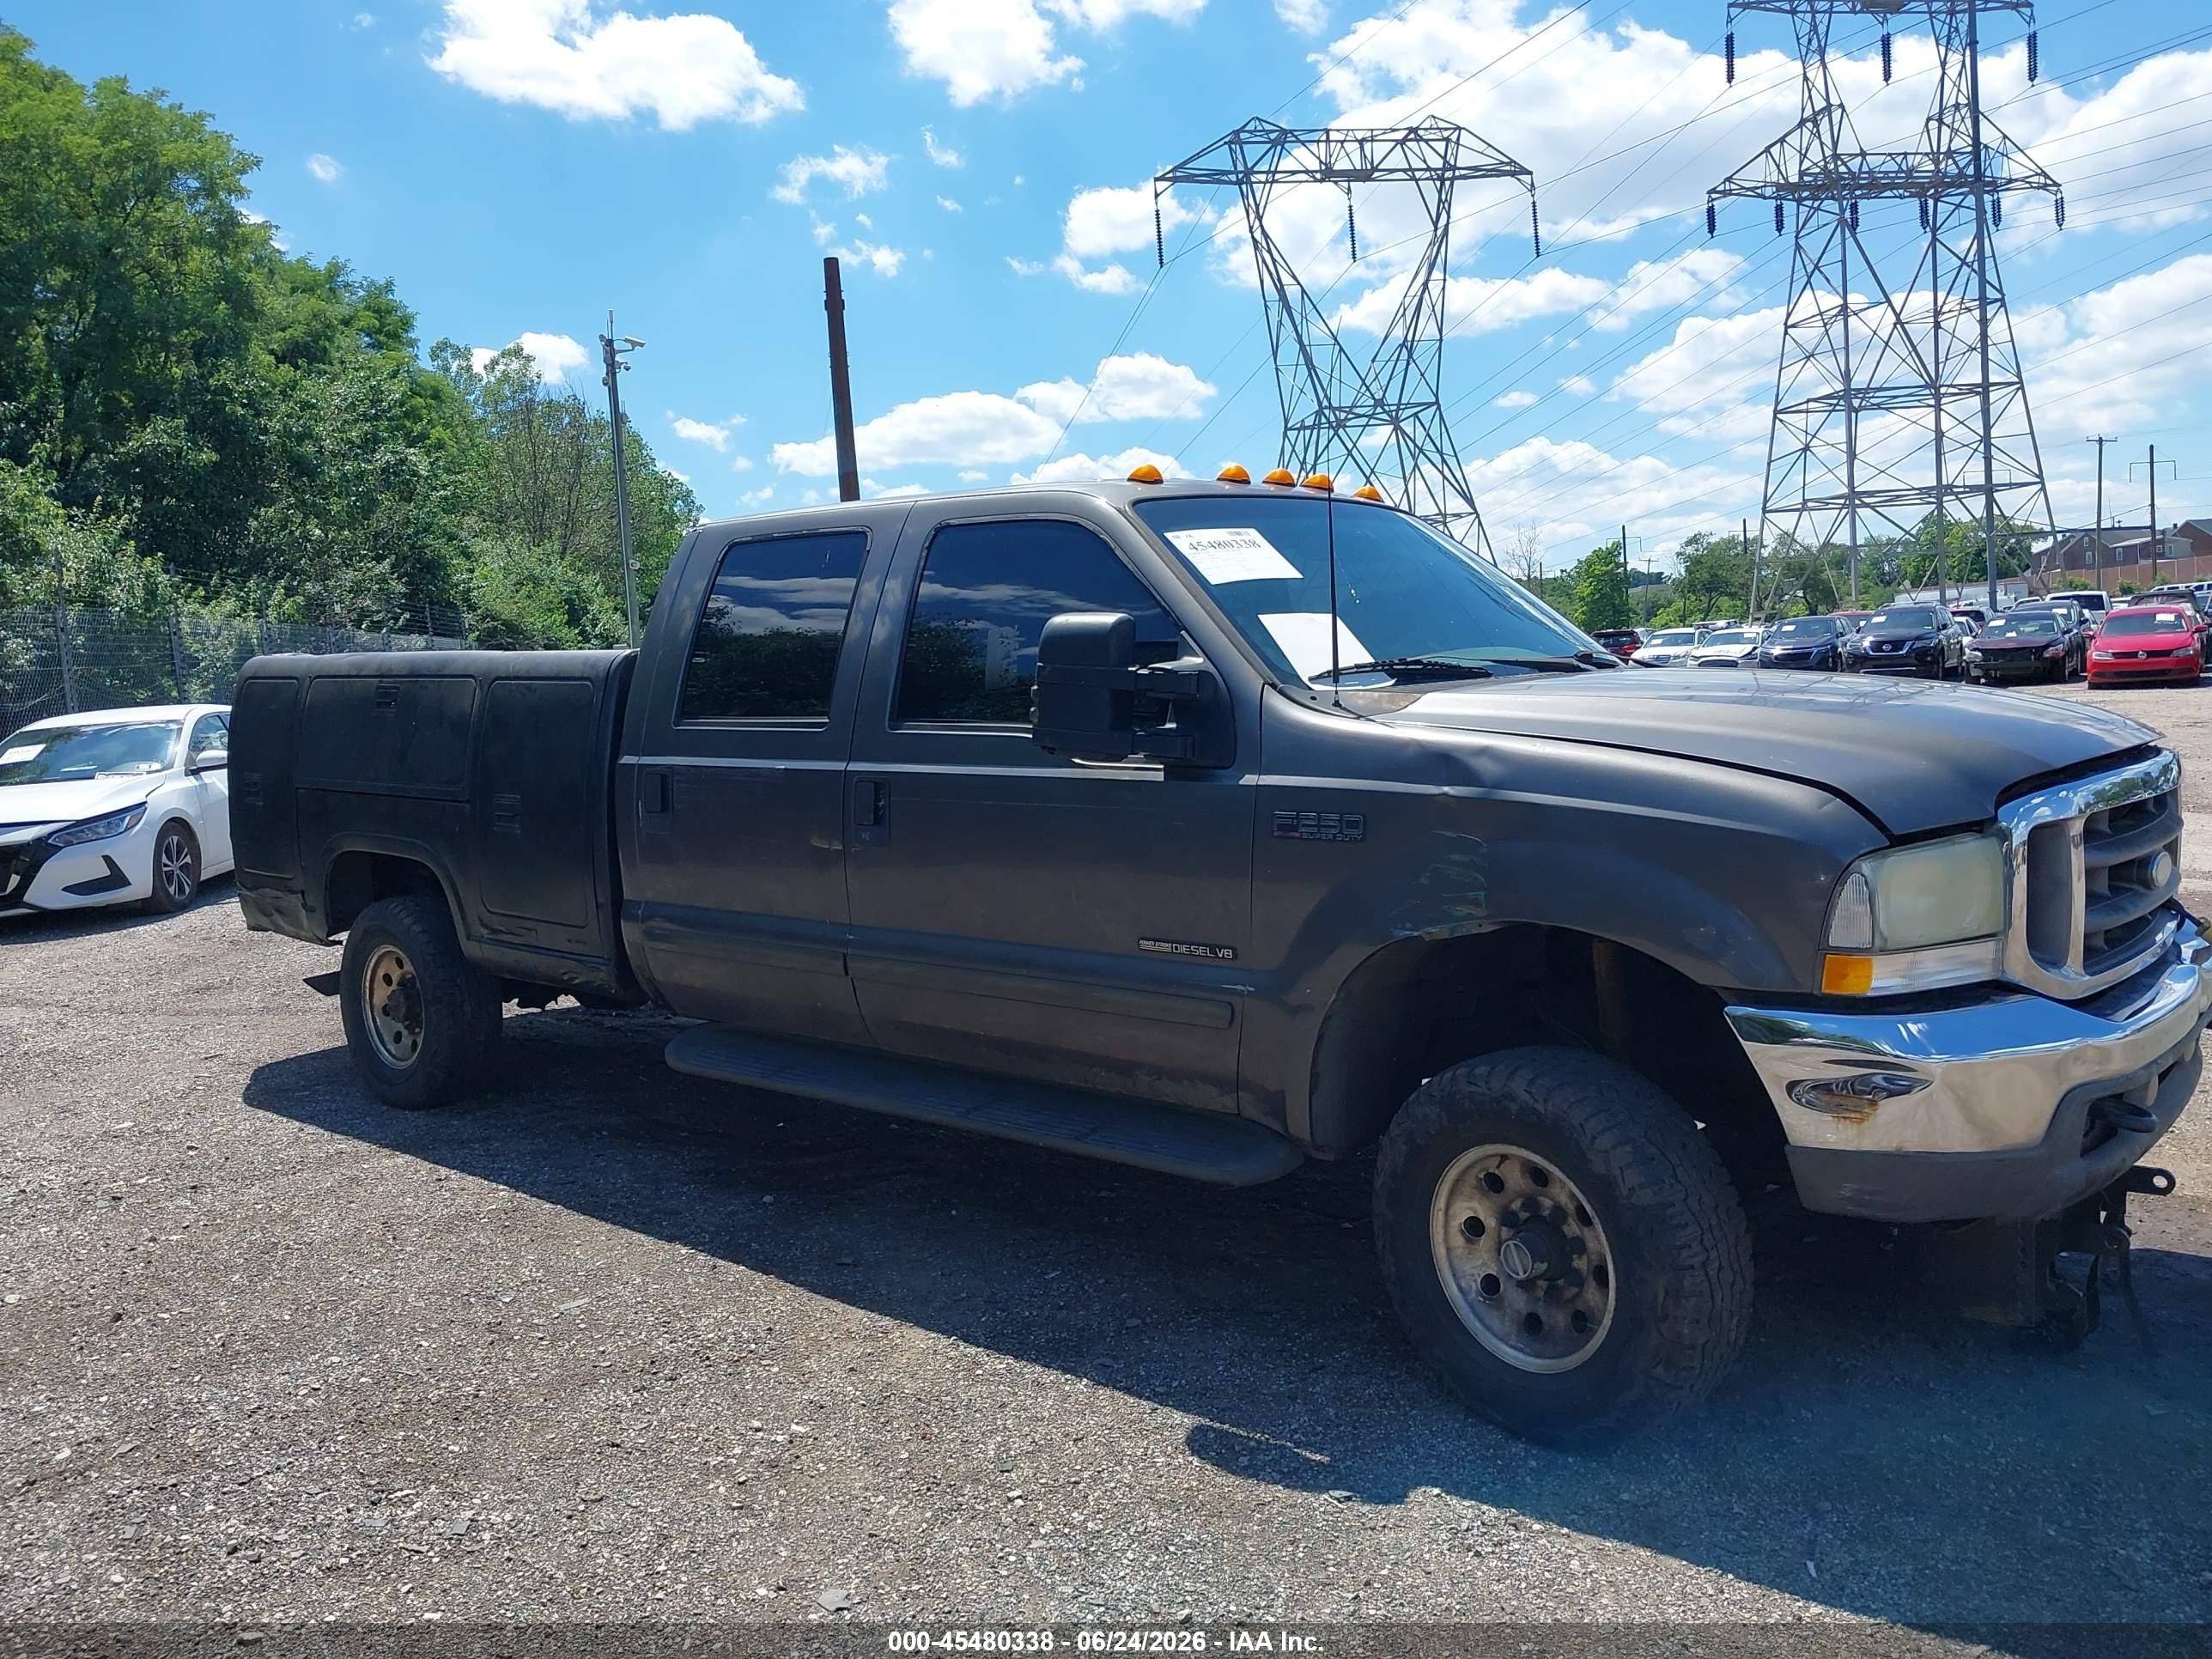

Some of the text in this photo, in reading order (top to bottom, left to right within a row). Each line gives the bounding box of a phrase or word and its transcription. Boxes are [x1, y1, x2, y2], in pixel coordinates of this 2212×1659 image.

[1188, 539, 1261, 551] 45480338
[1172, 944, 1233, 958] DIESEL V8
